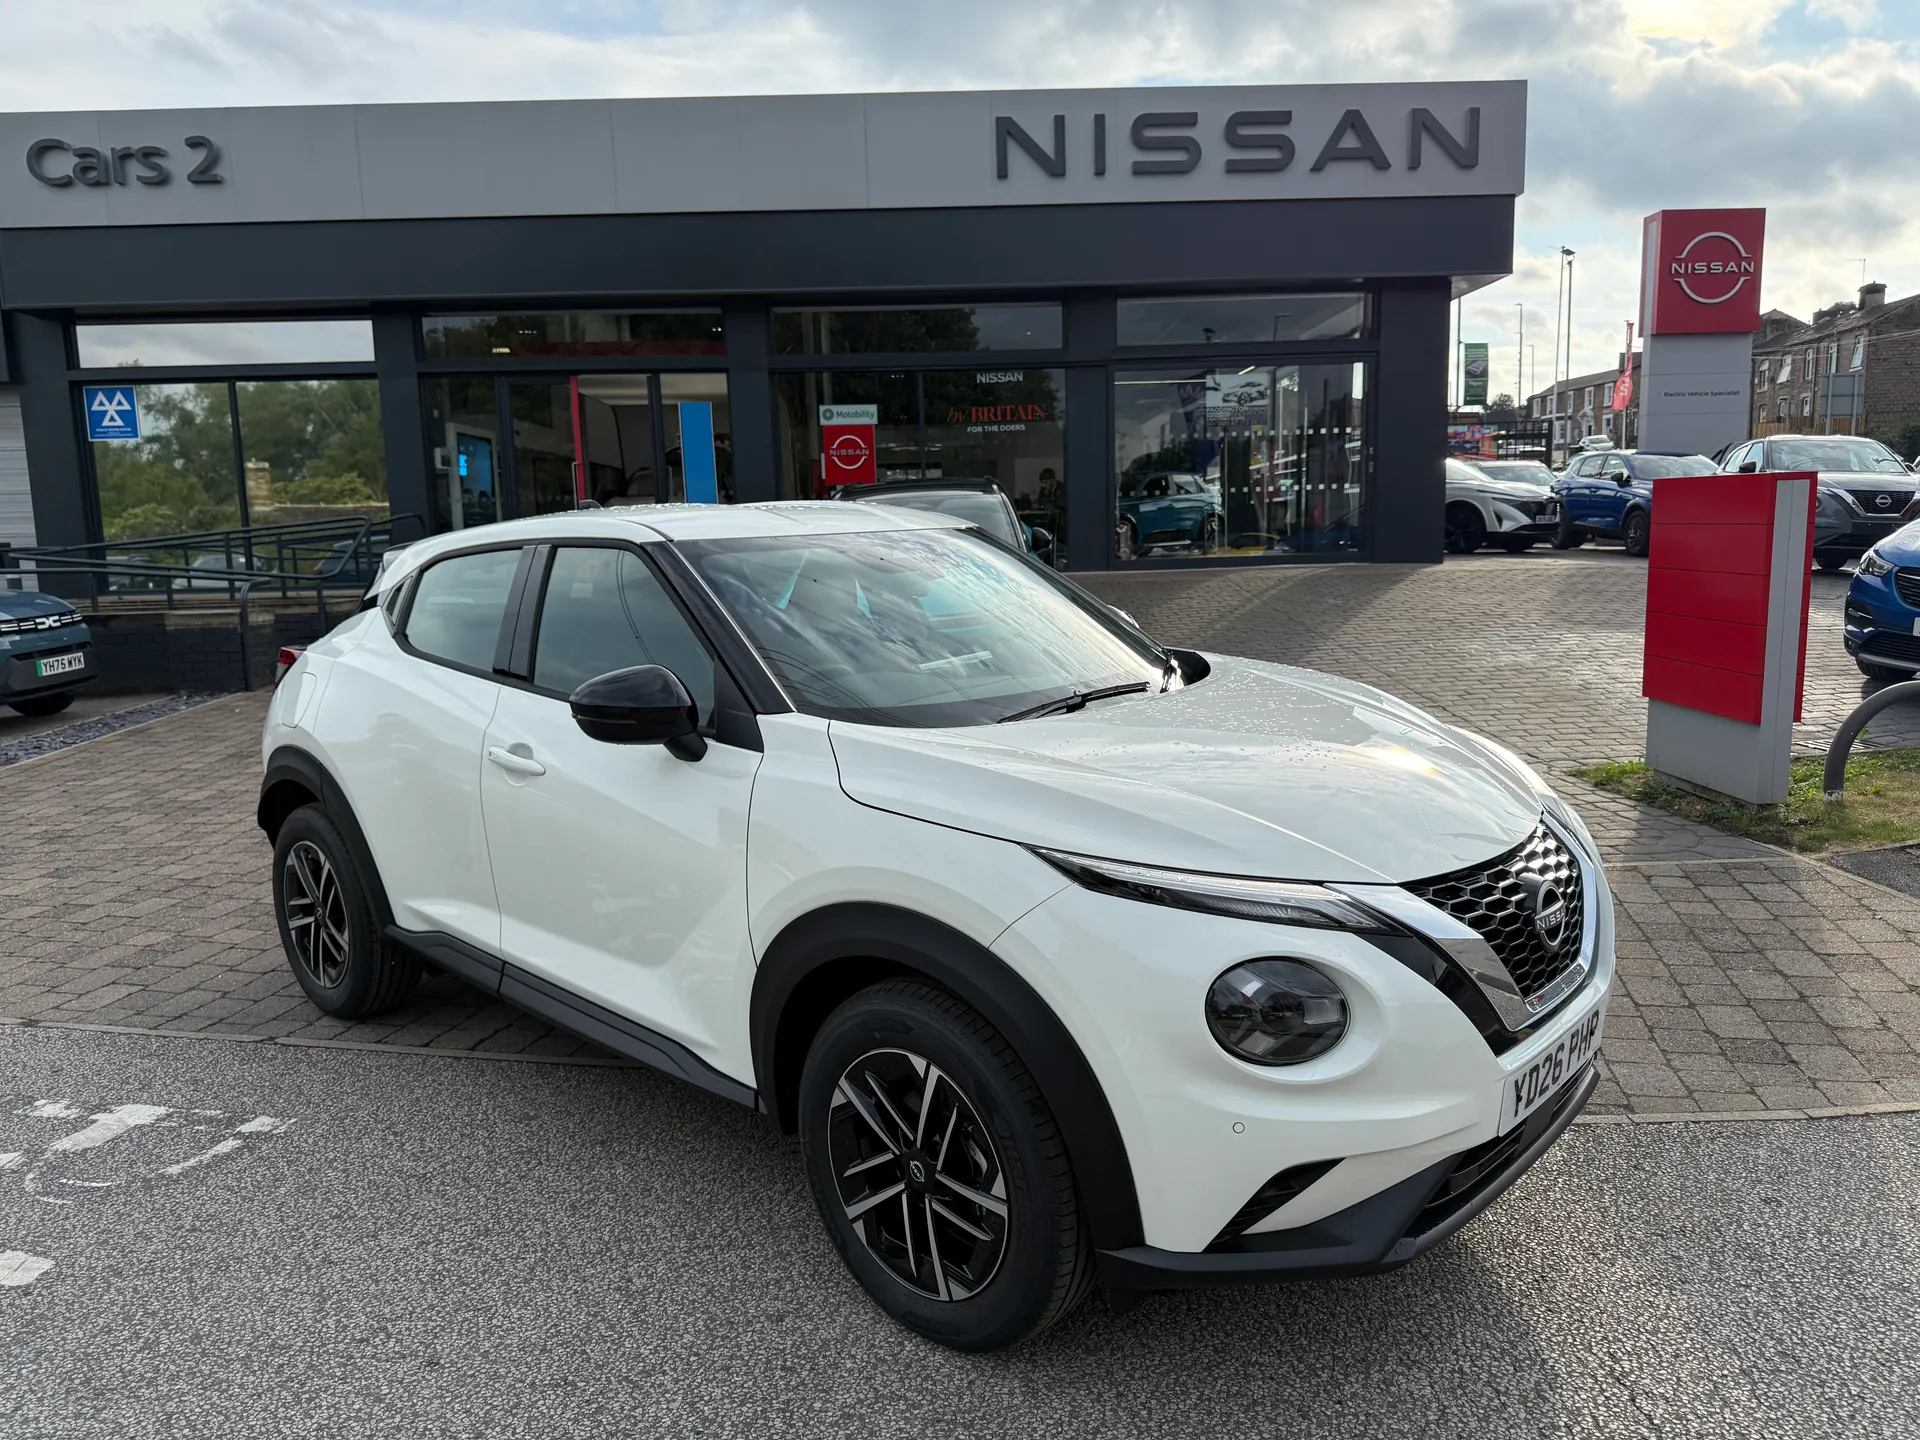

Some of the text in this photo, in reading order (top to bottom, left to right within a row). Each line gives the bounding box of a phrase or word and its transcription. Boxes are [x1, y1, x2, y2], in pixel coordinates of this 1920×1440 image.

[995, 106, 1481, 180] NISSAN
[26, 135, 224, 187] Cars 2
[1671, 261, 1755, 274] NISSAN
[976, 371, 1024, 384] NISSAN
[1710, 389, 1740, 397] Specialist
[836, 409, 875, 420] Motobility
[971, 403, 1046, 423] BRITAIN
[42, 658, 67, 674] YH75
[1537, 908, 1565, 930] NISS
[1514, 1009, 1600, 1118] YD26 PHP
